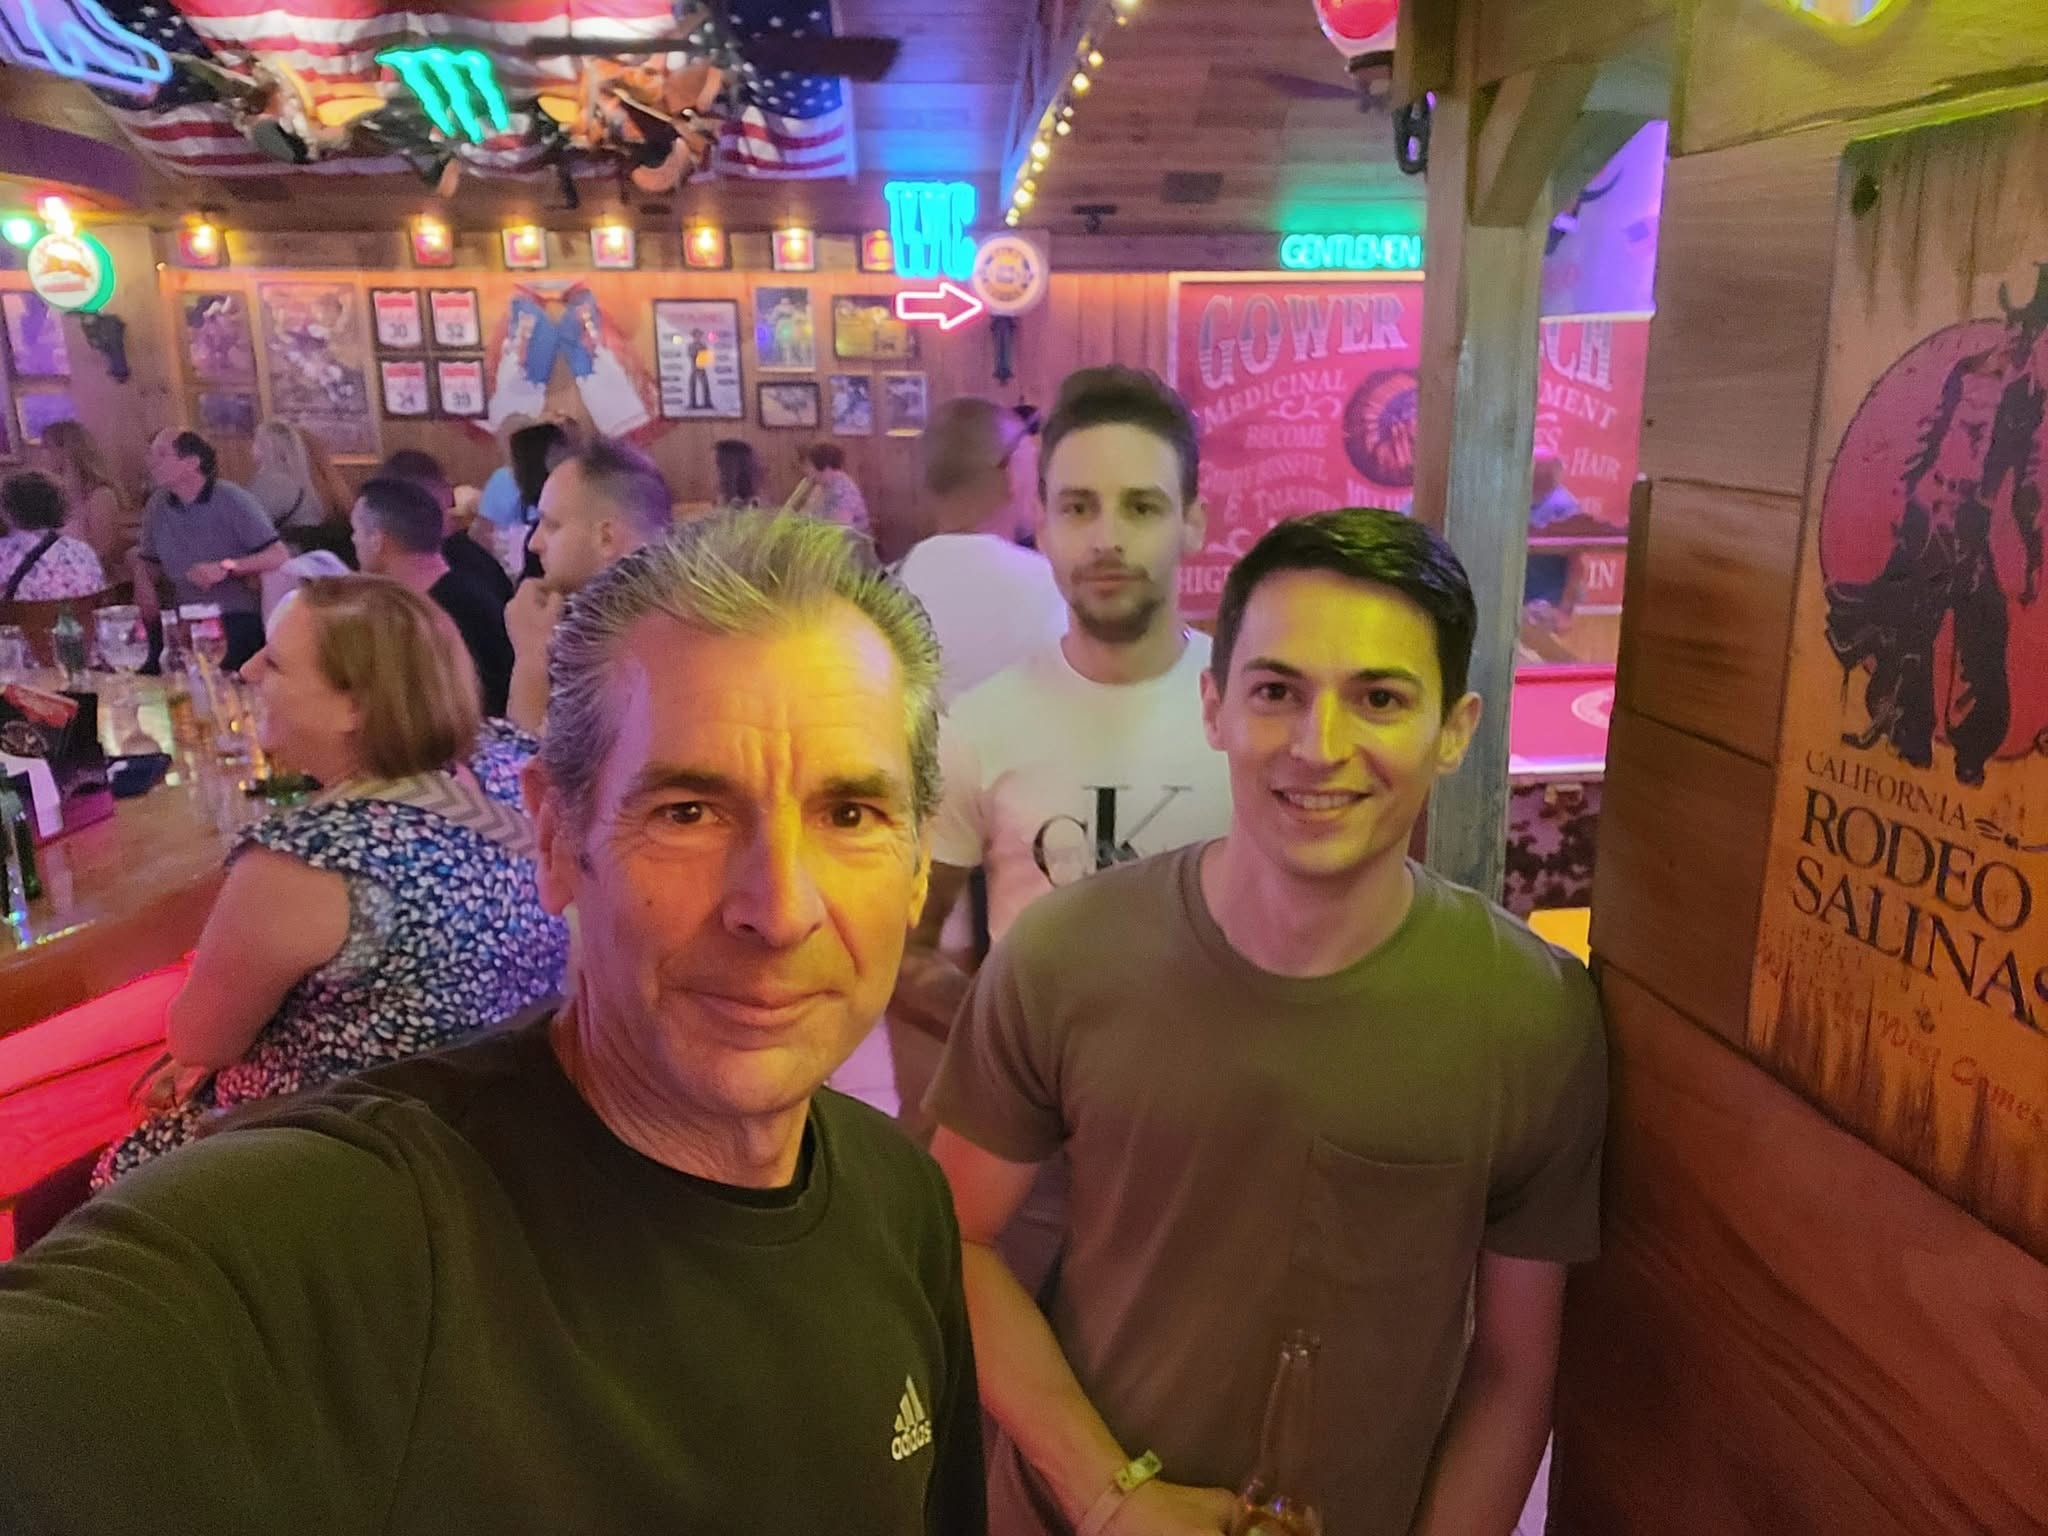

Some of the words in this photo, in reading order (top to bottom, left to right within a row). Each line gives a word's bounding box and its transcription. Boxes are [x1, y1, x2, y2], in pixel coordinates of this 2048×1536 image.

[1280, 233, 1421, 269] GENTLEMEN
[1199, 292, 1408, 390] GOWER
[1202, 368, 1347, 434] MEDICINAL
[1805, 748, 1968, 832] CALIFORNIA
[1800, 785, 2033, 934] RODEO
[891, 1420, 932, 1461] adidas
